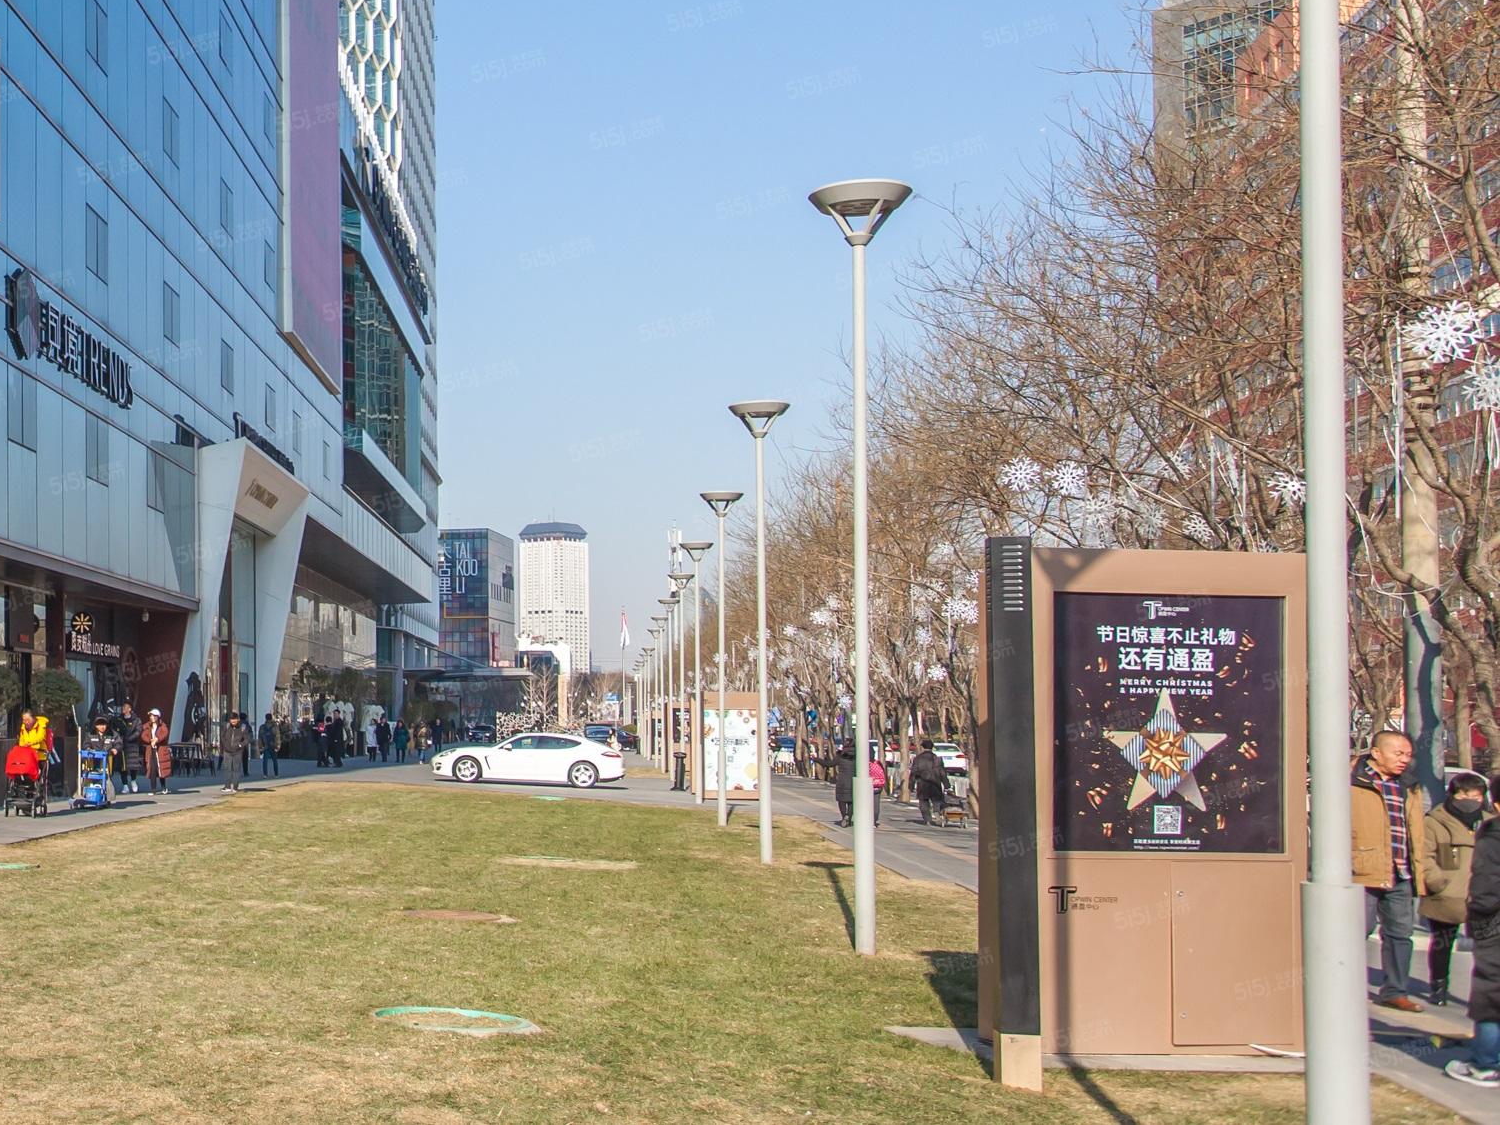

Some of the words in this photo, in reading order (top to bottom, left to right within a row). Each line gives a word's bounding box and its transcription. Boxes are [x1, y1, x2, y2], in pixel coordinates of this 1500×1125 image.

[80, 330, 134, 411] TRENDS
[455, 541, 470, 559] TAI
[456, 559, 478, 576] KOO
[456, 577, 465, 594] LI
[1097, 625, 1236, 645] 节日惊喜不止礼物
[1118, 646, 1214, 672] 还有通盈
[1120, 678, 1152, 686] MERRY
[1156, 679, 1213, 687] CHRISTMAS
[1130, 687, 1160, 695] HAPPY
[1190, 688, 1213, 696] YEAR
